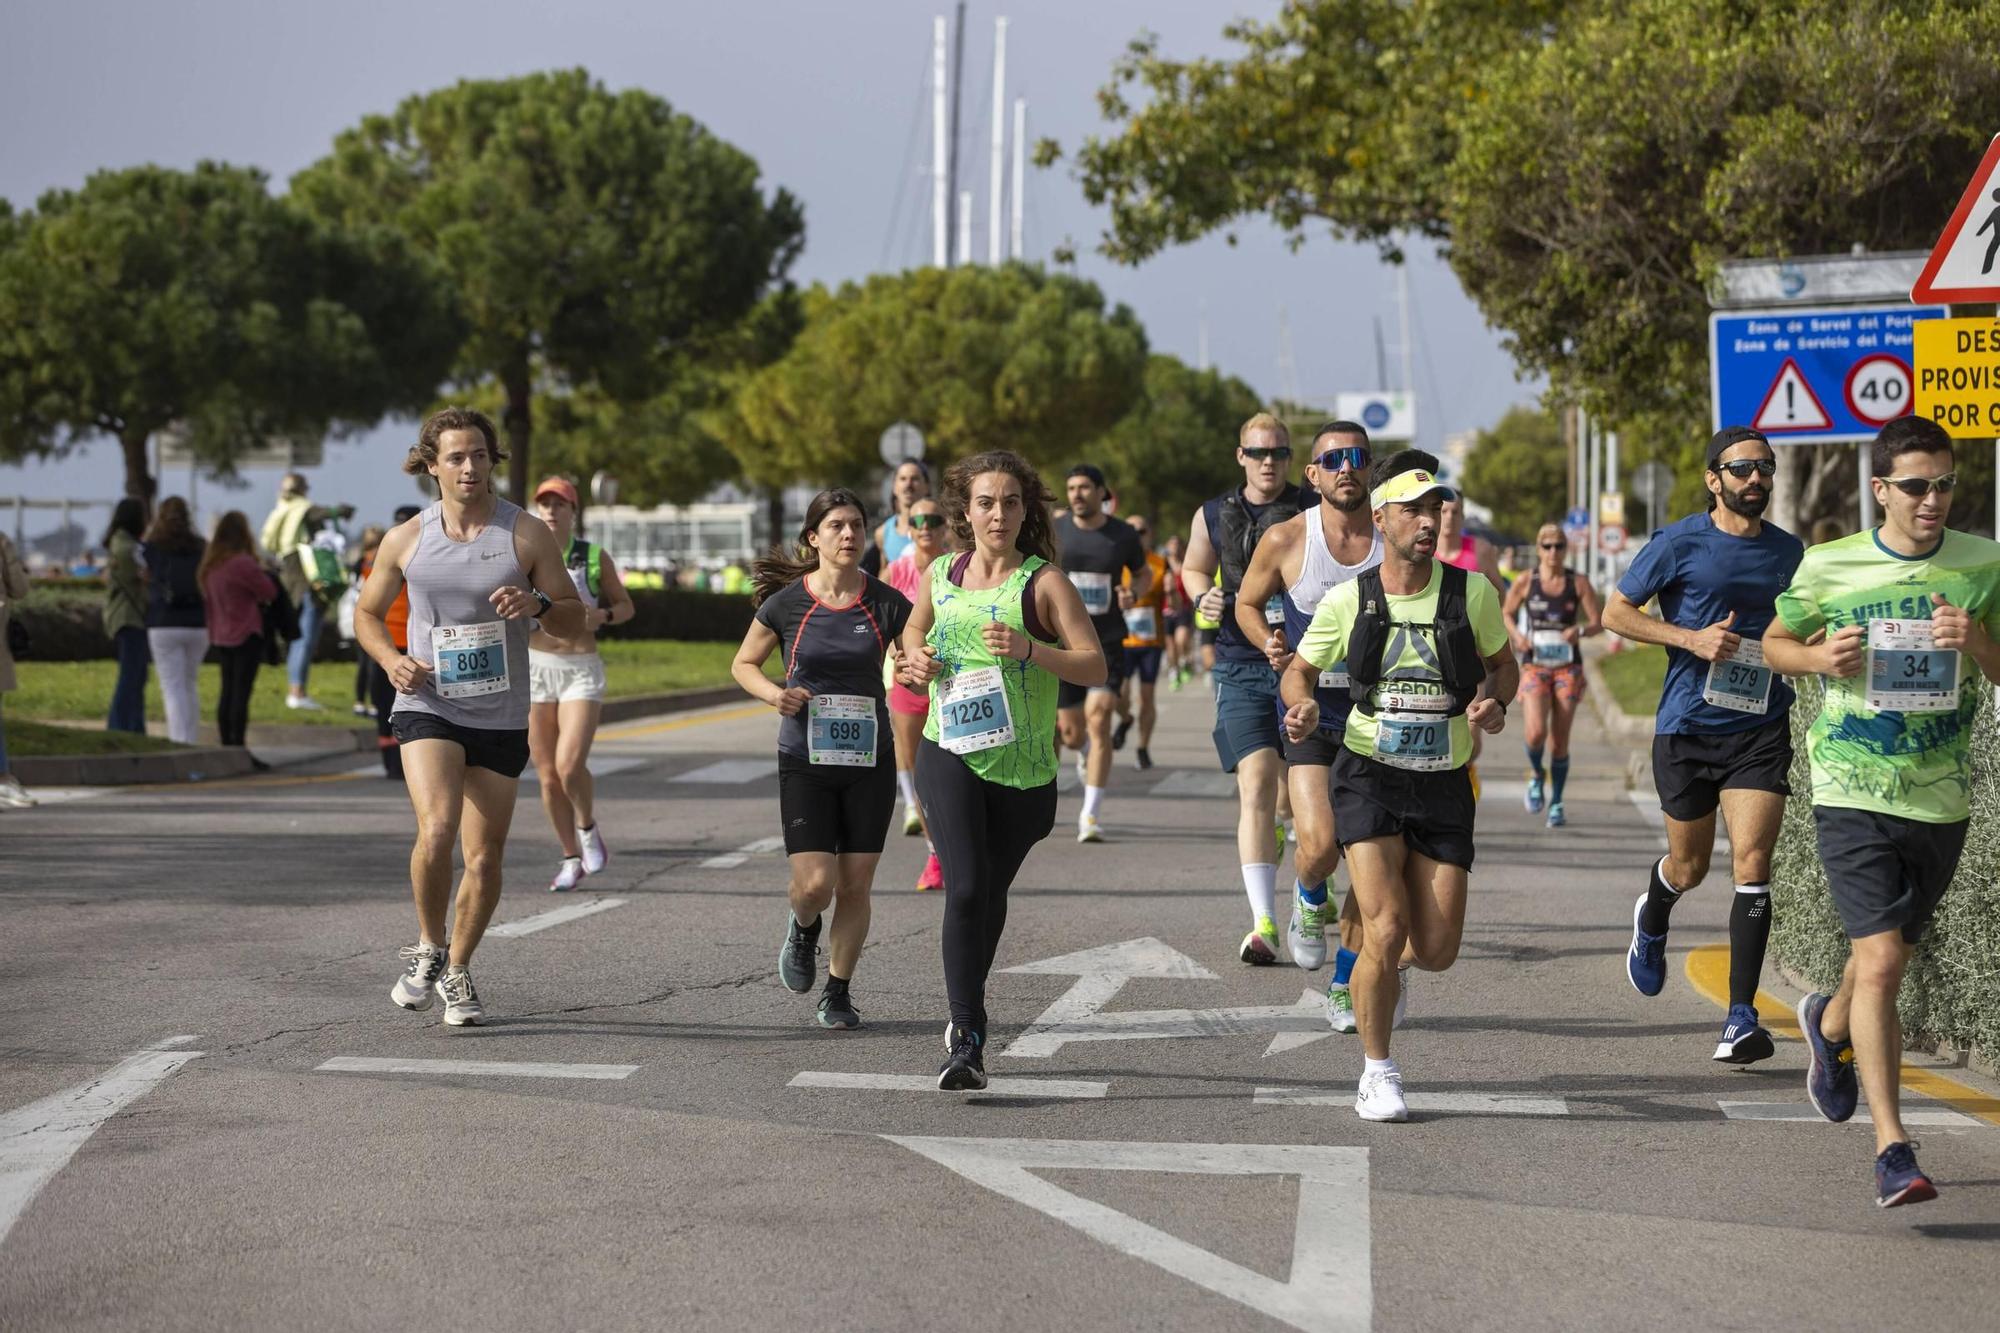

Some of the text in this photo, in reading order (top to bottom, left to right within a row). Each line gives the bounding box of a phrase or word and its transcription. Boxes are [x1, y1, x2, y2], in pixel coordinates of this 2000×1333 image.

[1787, 320, 1803, 333] de
[1858, 316, 1879, 330] del
[1774, 338, 1790, 351] de
[1798, 335, 1850, 350] Servicio
[1857, 333, 1878, 348] del
[1860, 378, 1903, 401] 40
[1933, 404, 1980, 427] POR
[443, 628, 457, 638] 31
[1884, 622, 1901, 634] 31
[457, 651, 489, 671] 803
[1903, 655, 1930, 677] 34
[1729, 665, 1758, 687] 579
[945, 680, 954, 691] 31
[819, 697, 833, 706] 31
[1390, 696, 1404, 707] 31
[951, 699, 994, 726] 1226
[830, 722, 860, 740] 698
[1400, 726, 1435, 745] 570
